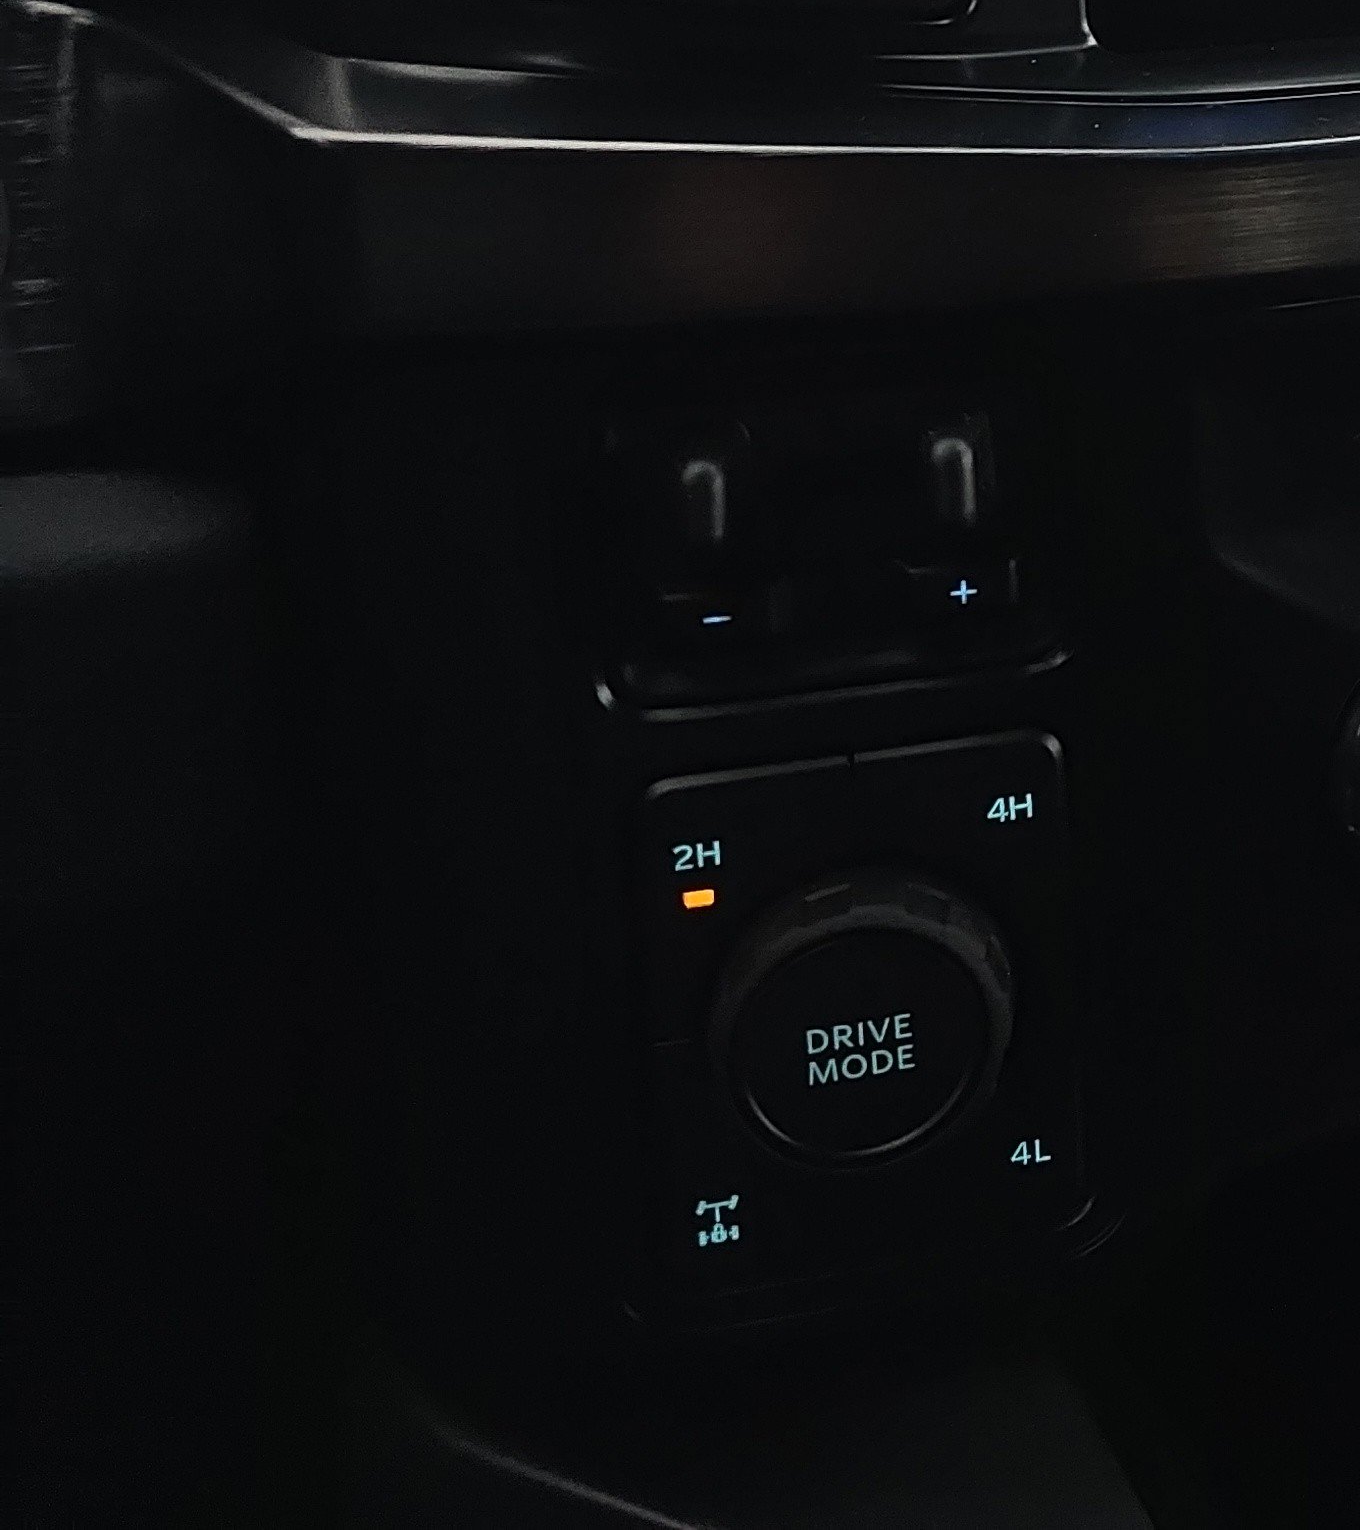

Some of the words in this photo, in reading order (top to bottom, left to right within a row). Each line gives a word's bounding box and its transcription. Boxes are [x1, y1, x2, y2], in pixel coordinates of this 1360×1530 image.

[986, 793, 1033, 823] 4H
[672, 840, 721, 872] 2H
[806, 1013, 914, 1055] DRIVE
[808, 1045, 916, 1087] MODE
[1010, 1138, 1052, 1166] 4L
